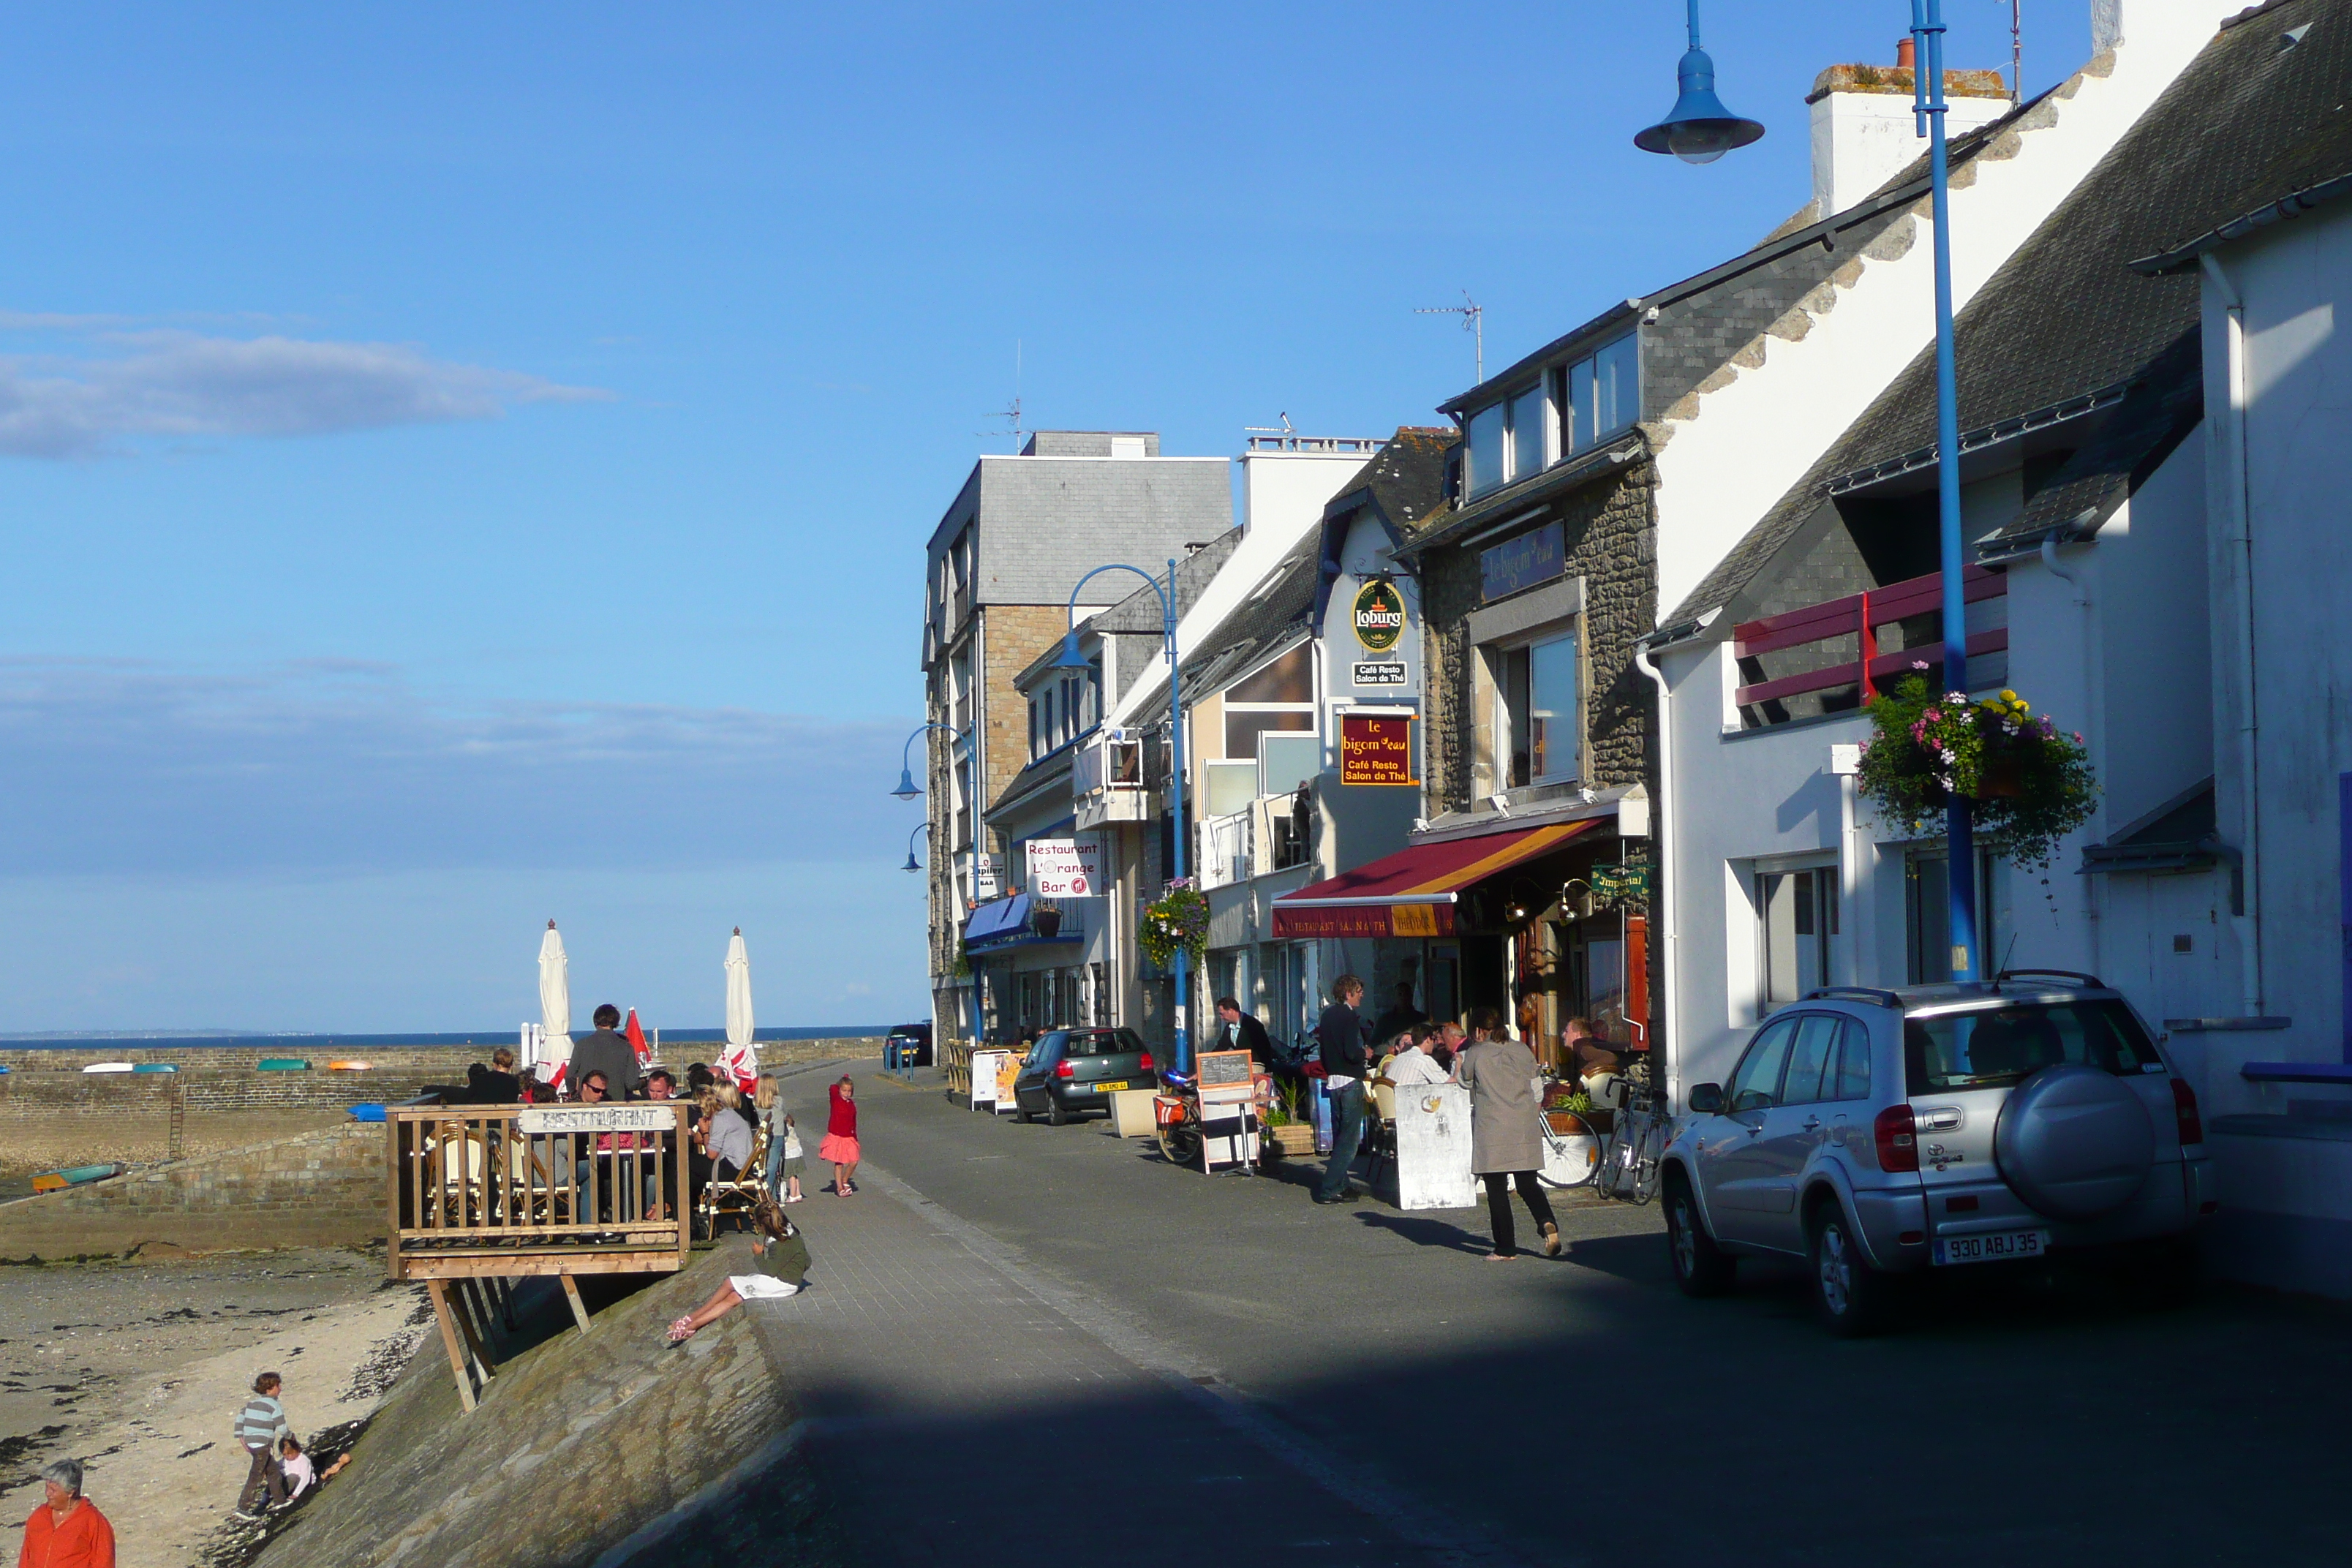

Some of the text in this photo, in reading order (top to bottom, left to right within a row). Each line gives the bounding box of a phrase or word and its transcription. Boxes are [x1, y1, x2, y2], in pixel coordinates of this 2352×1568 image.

[1356, 609, 1402, 627] Loburg
[1360, 665, 1400, 674] Café Resto
[1356, 674, 1404, 682] Salon de Thé
[1348, 760, 1398, 769] Café Resto
[1346, 771, 1406, 780] Salon de Thé
[1029, 843, 1098, 854] Restaurant
[1041, 881, 1066, 893] Bar
[1294, 921, 1335, 932] ESTAUANT
[541, 1109, 657, 1128] RESTAURANT
[1950, 1233, 2038, 1258] 930 ABJ 35
